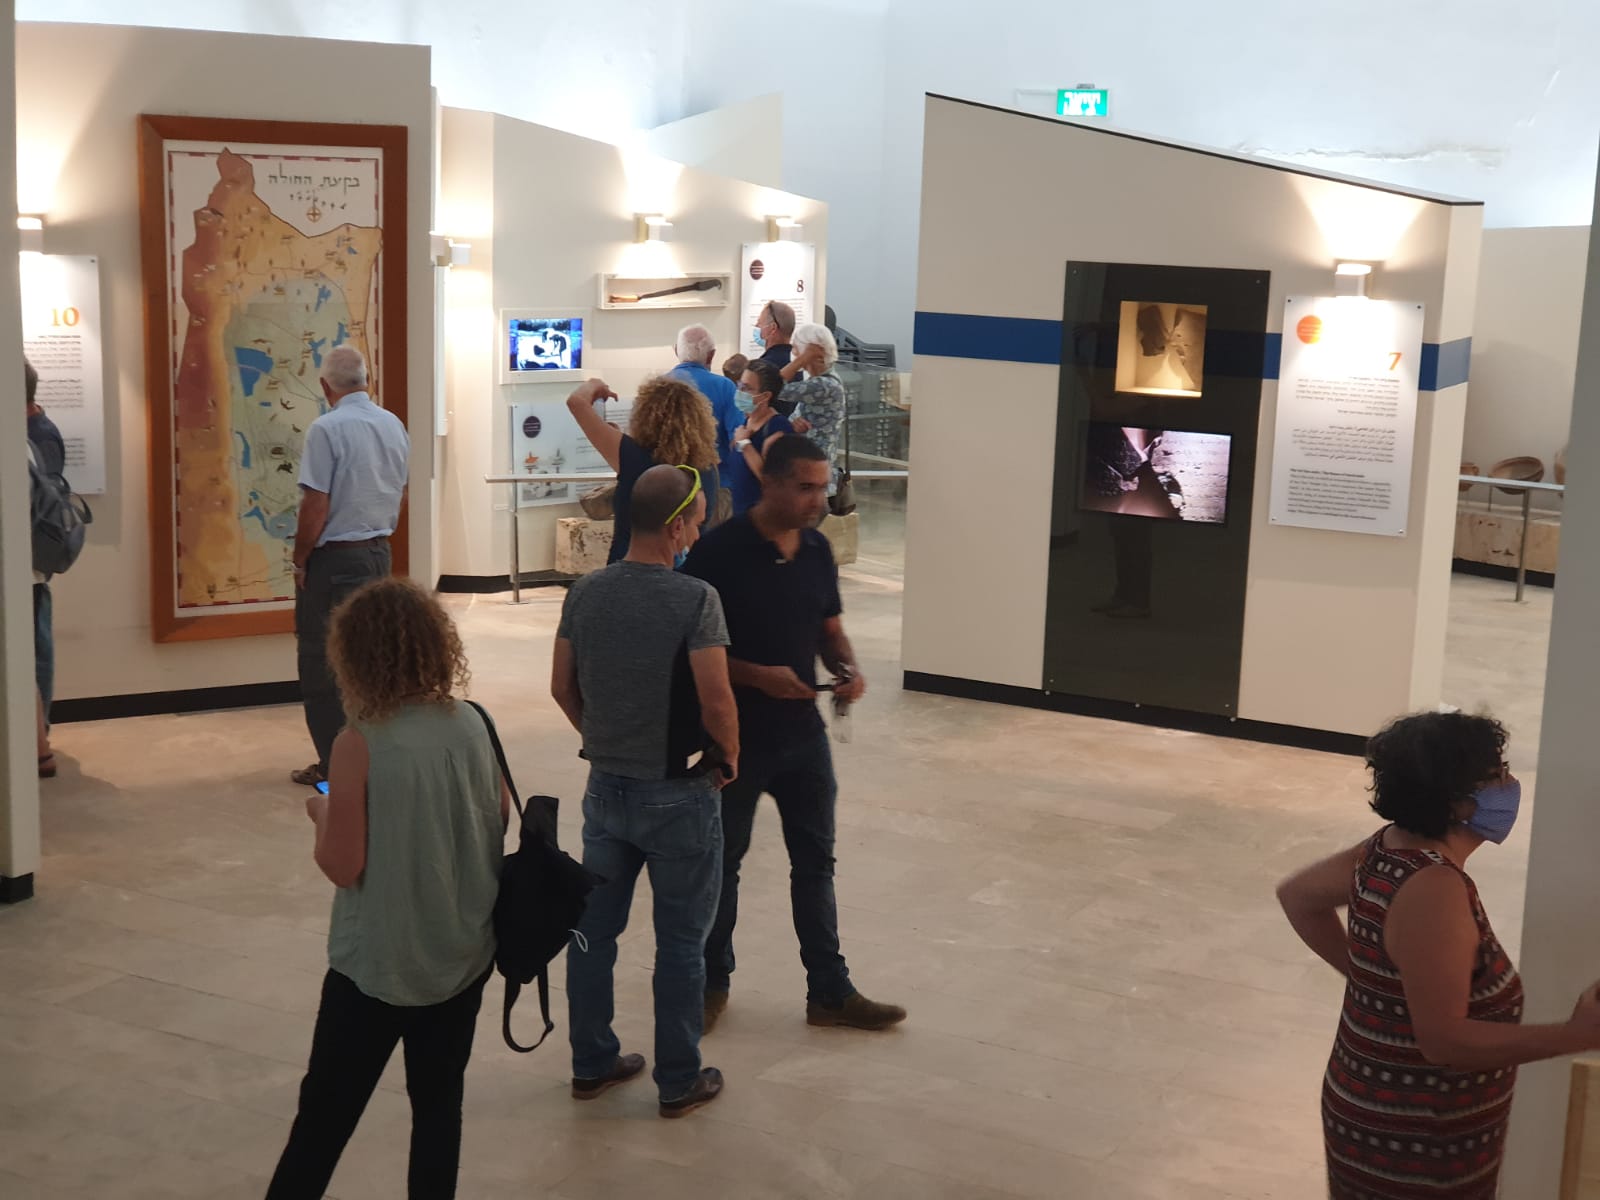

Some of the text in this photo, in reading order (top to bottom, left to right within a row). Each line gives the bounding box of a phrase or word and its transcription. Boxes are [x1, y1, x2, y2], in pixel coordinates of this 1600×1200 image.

[268, 163, 360, 195] בקעת החולה
[796, 279, 805, 293] 8
[51, 306, 80, 327] 10
[1388, 352, 1402, 371] 7
